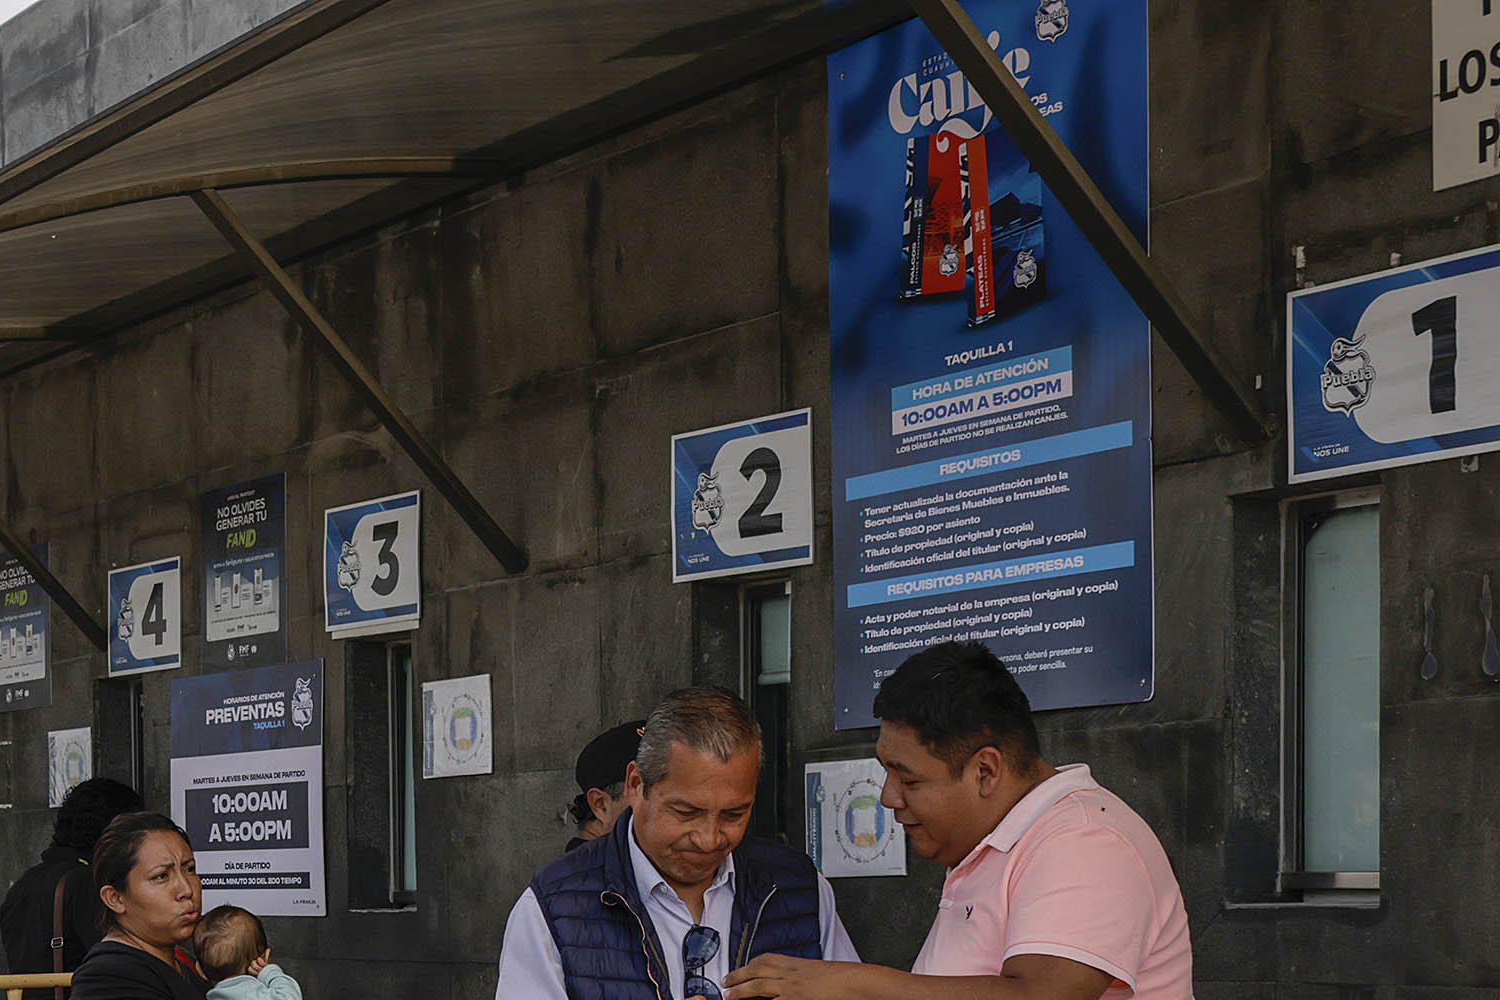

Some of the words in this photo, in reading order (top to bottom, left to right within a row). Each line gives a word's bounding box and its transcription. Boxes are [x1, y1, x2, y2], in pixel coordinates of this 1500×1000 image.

[922, 52, 950, 68] ESTAD
[978, 254, 986, 309] PLATEAS
[945, 343, 1006, 366] TAQUILLA
[1007, 340, 1014, 351] 1
[1412, 296, 1457, 414] 1
[912, 382, 952, 401] HORA
[954, 376, 973, 391] DE
[975, 358, 1049, 386] ATENCIÓN
[1321, 366, 1376, 391] Puebla
[902, 398, 974, 427] 10:00AM
[977, 396, 990, 410] A
[992, 379, 1062, 407] 5:00PM
[896, 445, 911, 454] LOS
[911, 441, 929, 451] DÍAS
[929, 439, 939, 448] DE
[939, 432, 972, 446] PARTIDO
[972, 429, 985, 439] NO
[985, 426, 995, 436] SE
[996, 419, 1034, 434] REALIZAN
[902, 433, 933, 444] MARTES
[939, 424, 968, 437] JUEVES
[968, 422, 979, 431] EN
[980, 416, 1012, 428] SEMANA
[1013, 412, 1024, 422] DE
[939, 449, 1022, 476] REQUISITOS
[1314, 449, 1331, 457] NOS
[1332, 445, 1350, 455] UNE
[738, 447, 783, 538] 2
[864, 505, 892, 516] Tener
[892, 494, 944, 511] actualizada
[945, 492, 955, 502] la
[955, 478, 1033, 499] documentación
[1034, 474, 1058, 485] ante
[1059, 471, 1069, 480] la
[915, 509, 927, 519] de
[928, 503, 960, 514] Bienes
[962, 497, 1004, 511] Muebles
[1005, 495, 1013, 503] e
[1013, 485, 1070, 501] Inmuebles.
[216, 513, 254, 531] GENERAR
[255, 509, 267, 522] TU
[217, 506, 230, 519] NO
[231, 498, 266, 516] OLVIDES
[864, 531, 898, 544] Precio:
[926, 522, 944, 534] por
[945, 515, 981, 529] asiento
[891, 545, 903, 554] de
[904, 535, 953, 553] propiedad
[954, 528, 994, 544] (original
[995, 528, 1002, 538] y
[1003, 520, 1035, 535] copia)
[371, 520, 399, 596] 3
[865, 555, 926, 574] Identificación
[926, 550, 955, 563] oficial
[955, 546, 970, 558] del
[972, 544, 1002, 556] titular
[1003, 535, 1045, 552] (original
[1046, 534, 1053, 545] y
[1054, 528, 1087, 542] copia)
[887, 573, 965, 596] REQUISITOS
[965, 567, 1003, 584] PARA
[1005, 555, 1084, 577] EMPRESAS
[141, 582, 167, 646] 4
[864, 615, 886, 625] Acta
[886, 614, 893, 623] y
[893, 609, 921, 622] poder
[922, 602, 959, 616] notarial
[960, 601, 973, 610] de
[974, 600, 983, 609] la
[984, 594, 1031, 608] empresa
[1032, 586, 1075, 602] (original
[1076, 586, 1084, 597] y
[1085, 580, 1119, 594] copia)
[864, 638, 924, 654] Identificación
[953, 630, 969, 642] del
[969, 627, 1000, 640] titular
[1001, 622, 1043, 638] (original
[1044, 623, 1051, 633] y
[1052, 616, 1086, 631] copia)
[890, 626, 902, 636] de
[903, 619, 952, 634] propiedad
[952, 612, 993, 628] (original
[993, 613, 1000, 623] y
[1001, 607, 1033, 621] copia)
[999, 655, 1023, 664] ersona,
[1024, 649, 1048, 660] deberá
[1049, 646, 1083, 658] presentar
[1084, 646, 1093, 654] su
[1018, 664, 1038, 674] poder
[223, 695, 250, 705] HORARIOS
[250, 694, 258, 702] DE
[258, 691, 285, 701] ATENCIÓN
[206, 701, 285, 725] PREVENTAS
[253, 720, 281, 730] TAQUILLA
[193, 777, 215, 785] MARTES
[220, 775, 242, 783] JUEVES
[242, 774, 249, 782] EN
[250, 772, 273, 781] SEMANA
[274, 771, 281, 779] DE
[282, 770, 306, 779] PARTIDO
[212, 790, 288, 814] 10:00AM
[208, 823, 222, 843] A
[224, 819, 292, 843] 5:00PM
[224, 861, 236, 870] DÍA
[236, 862, 244, 870] DE
[244, 861, 271, 870] PARTIDO
[219, 877, 226, 885] AL
[226, 877, 247, 885] MINUTO
[256, 876, 267, 885] DEL
[280, 876, 302, 885] TIEMPO
